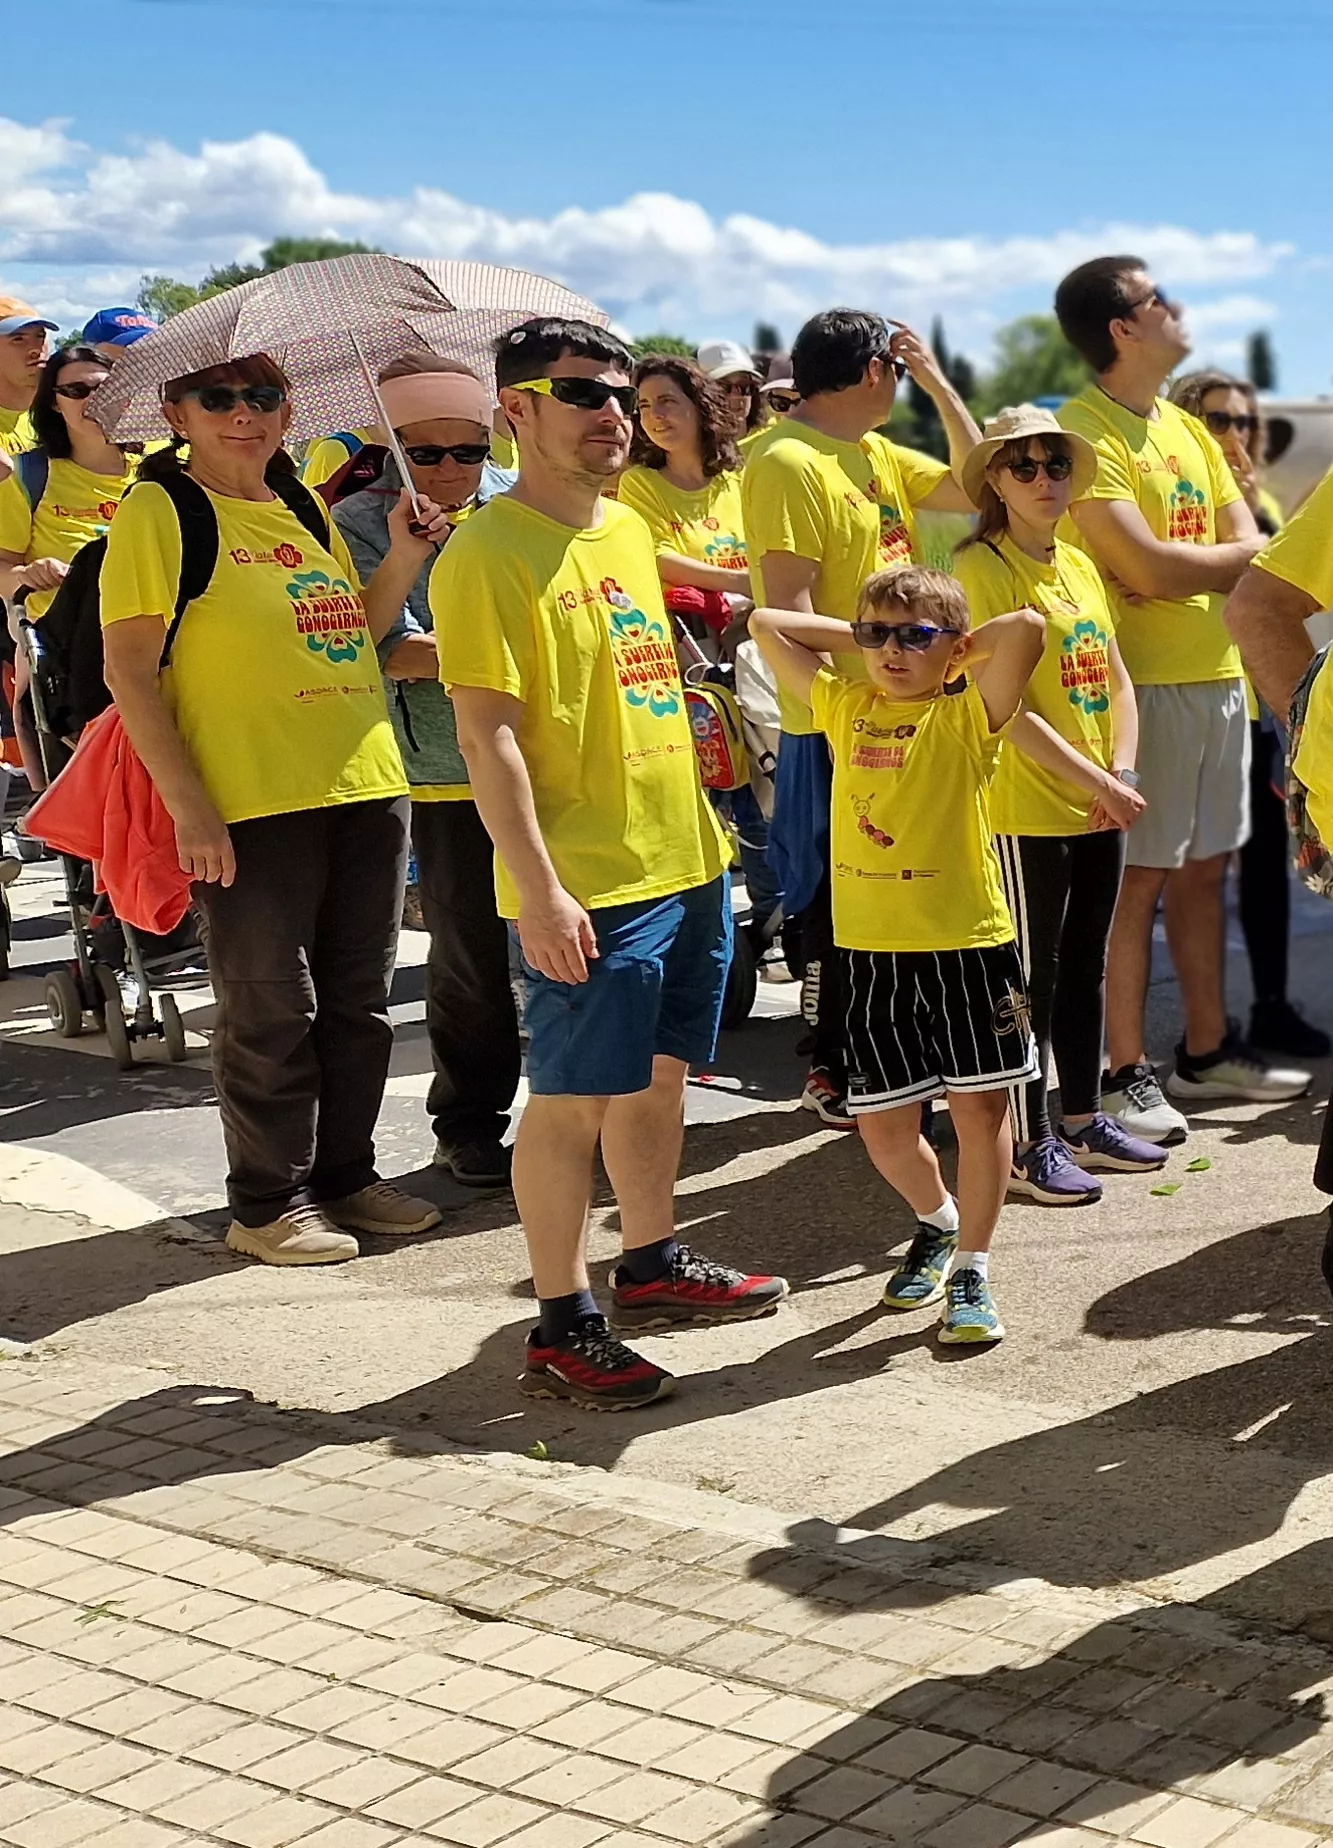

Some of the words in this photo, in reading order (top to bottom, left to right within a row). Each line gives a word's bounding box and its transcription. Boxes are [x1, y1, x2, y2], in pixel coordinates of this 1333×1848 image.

[229, 548, 251, 565] 13
[557, 590, 577, 611] 13
[1060, 654, 1075, 671] LA
